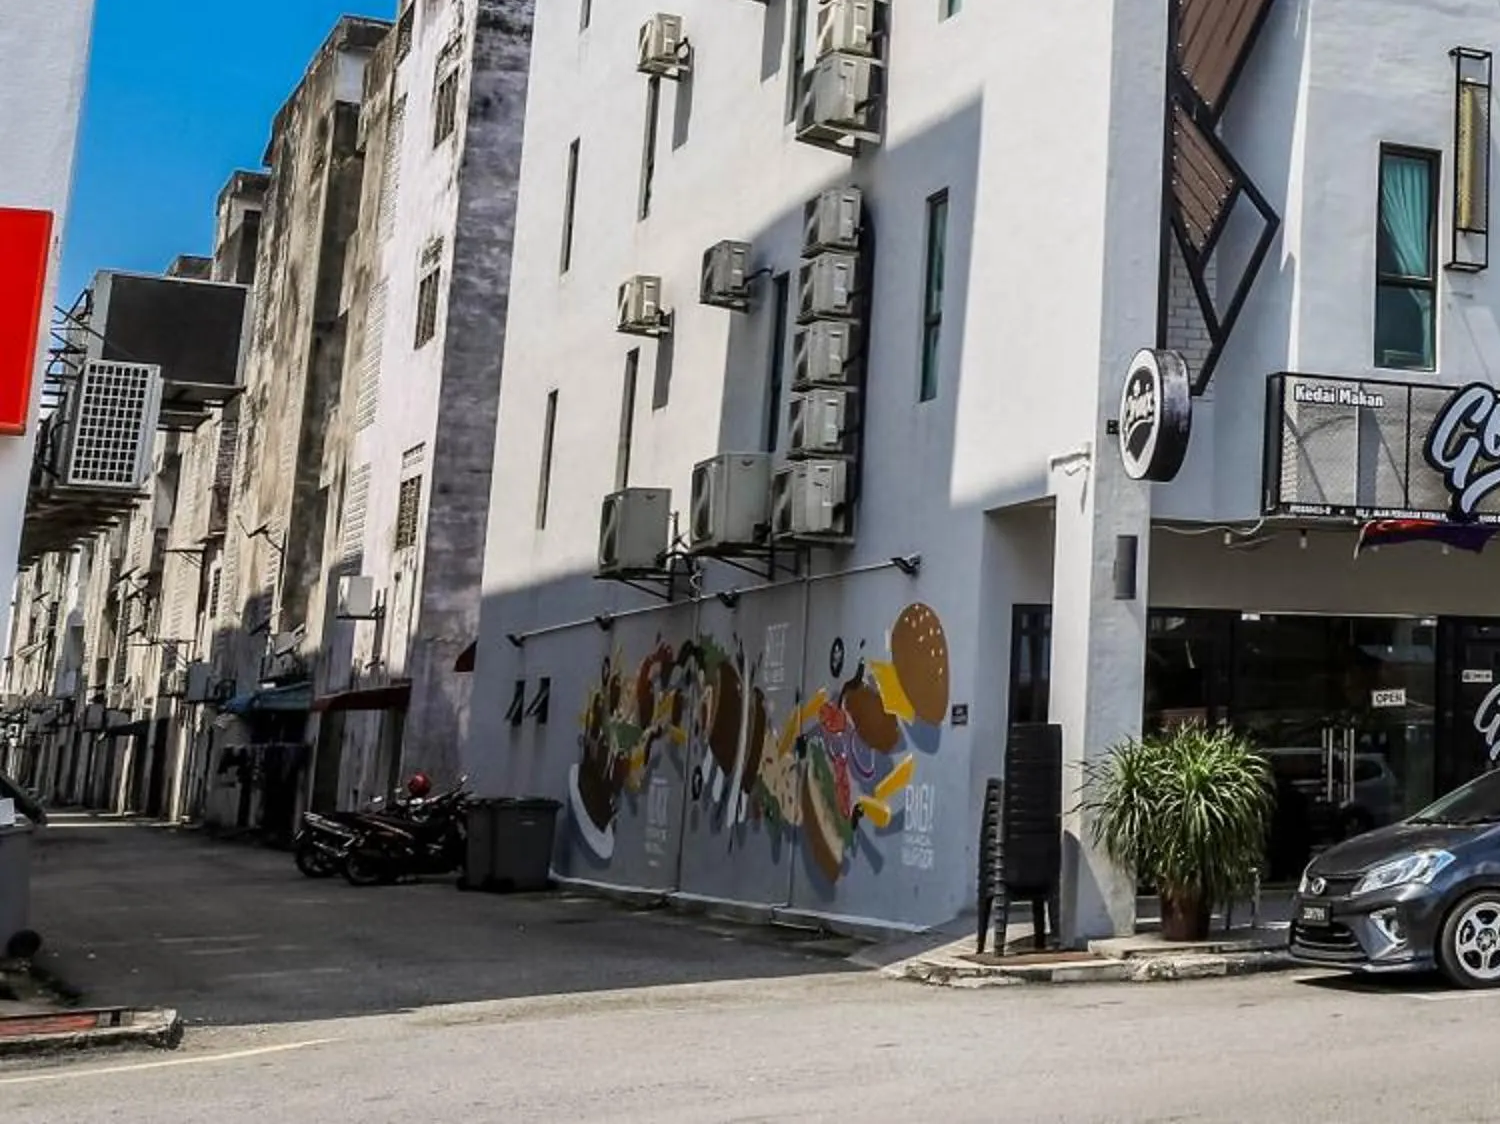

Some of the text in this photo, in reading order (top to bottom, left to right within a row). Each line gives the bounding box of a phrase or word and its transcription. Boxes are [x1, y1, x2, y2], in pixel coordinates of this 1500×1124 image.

[1295, 384, 1383, 407] Kedai Makan
[1375, 692, 1403, 706] OPEN
